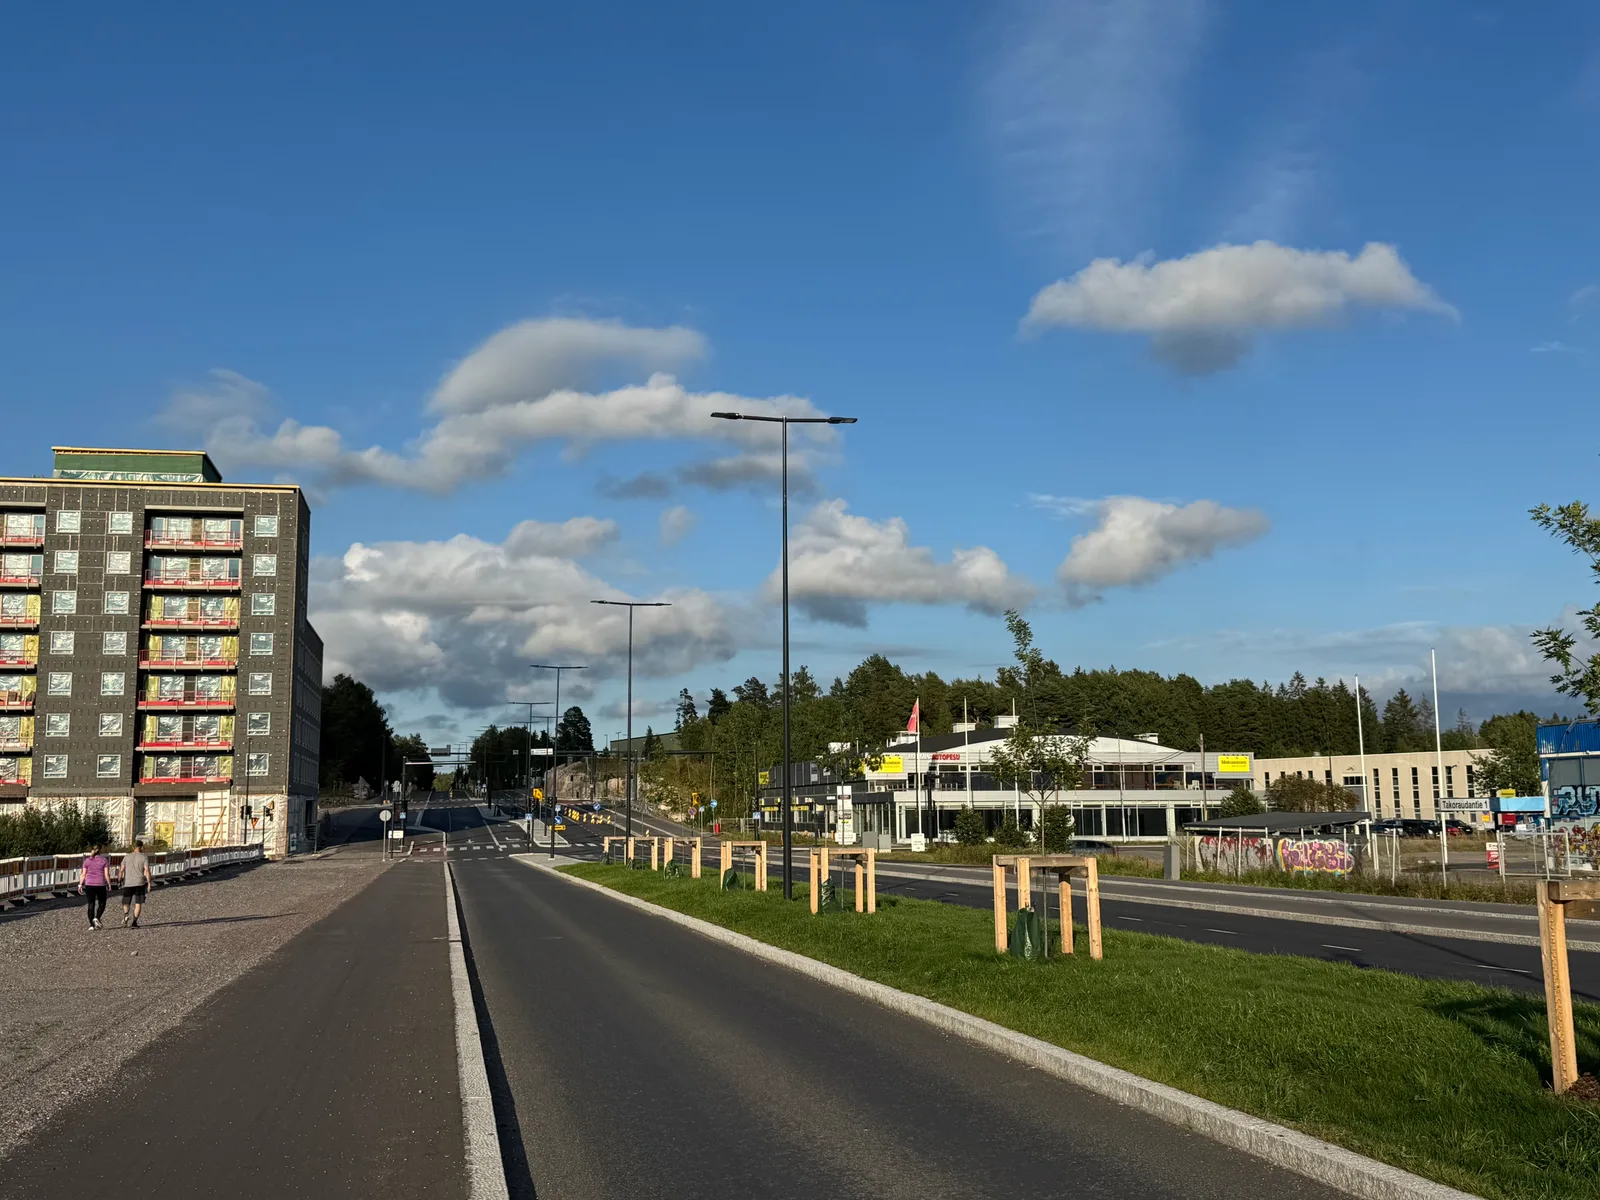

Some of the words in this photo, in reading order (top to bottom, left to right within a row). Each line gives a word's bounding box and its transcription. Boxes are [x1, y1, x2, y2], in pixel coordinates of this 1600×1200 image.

[931, 753, 960, 761] AUTOPESU
[1442, 800, 1483, 809] Takoraudantie
[1484, 800, 1488, 809] 1
